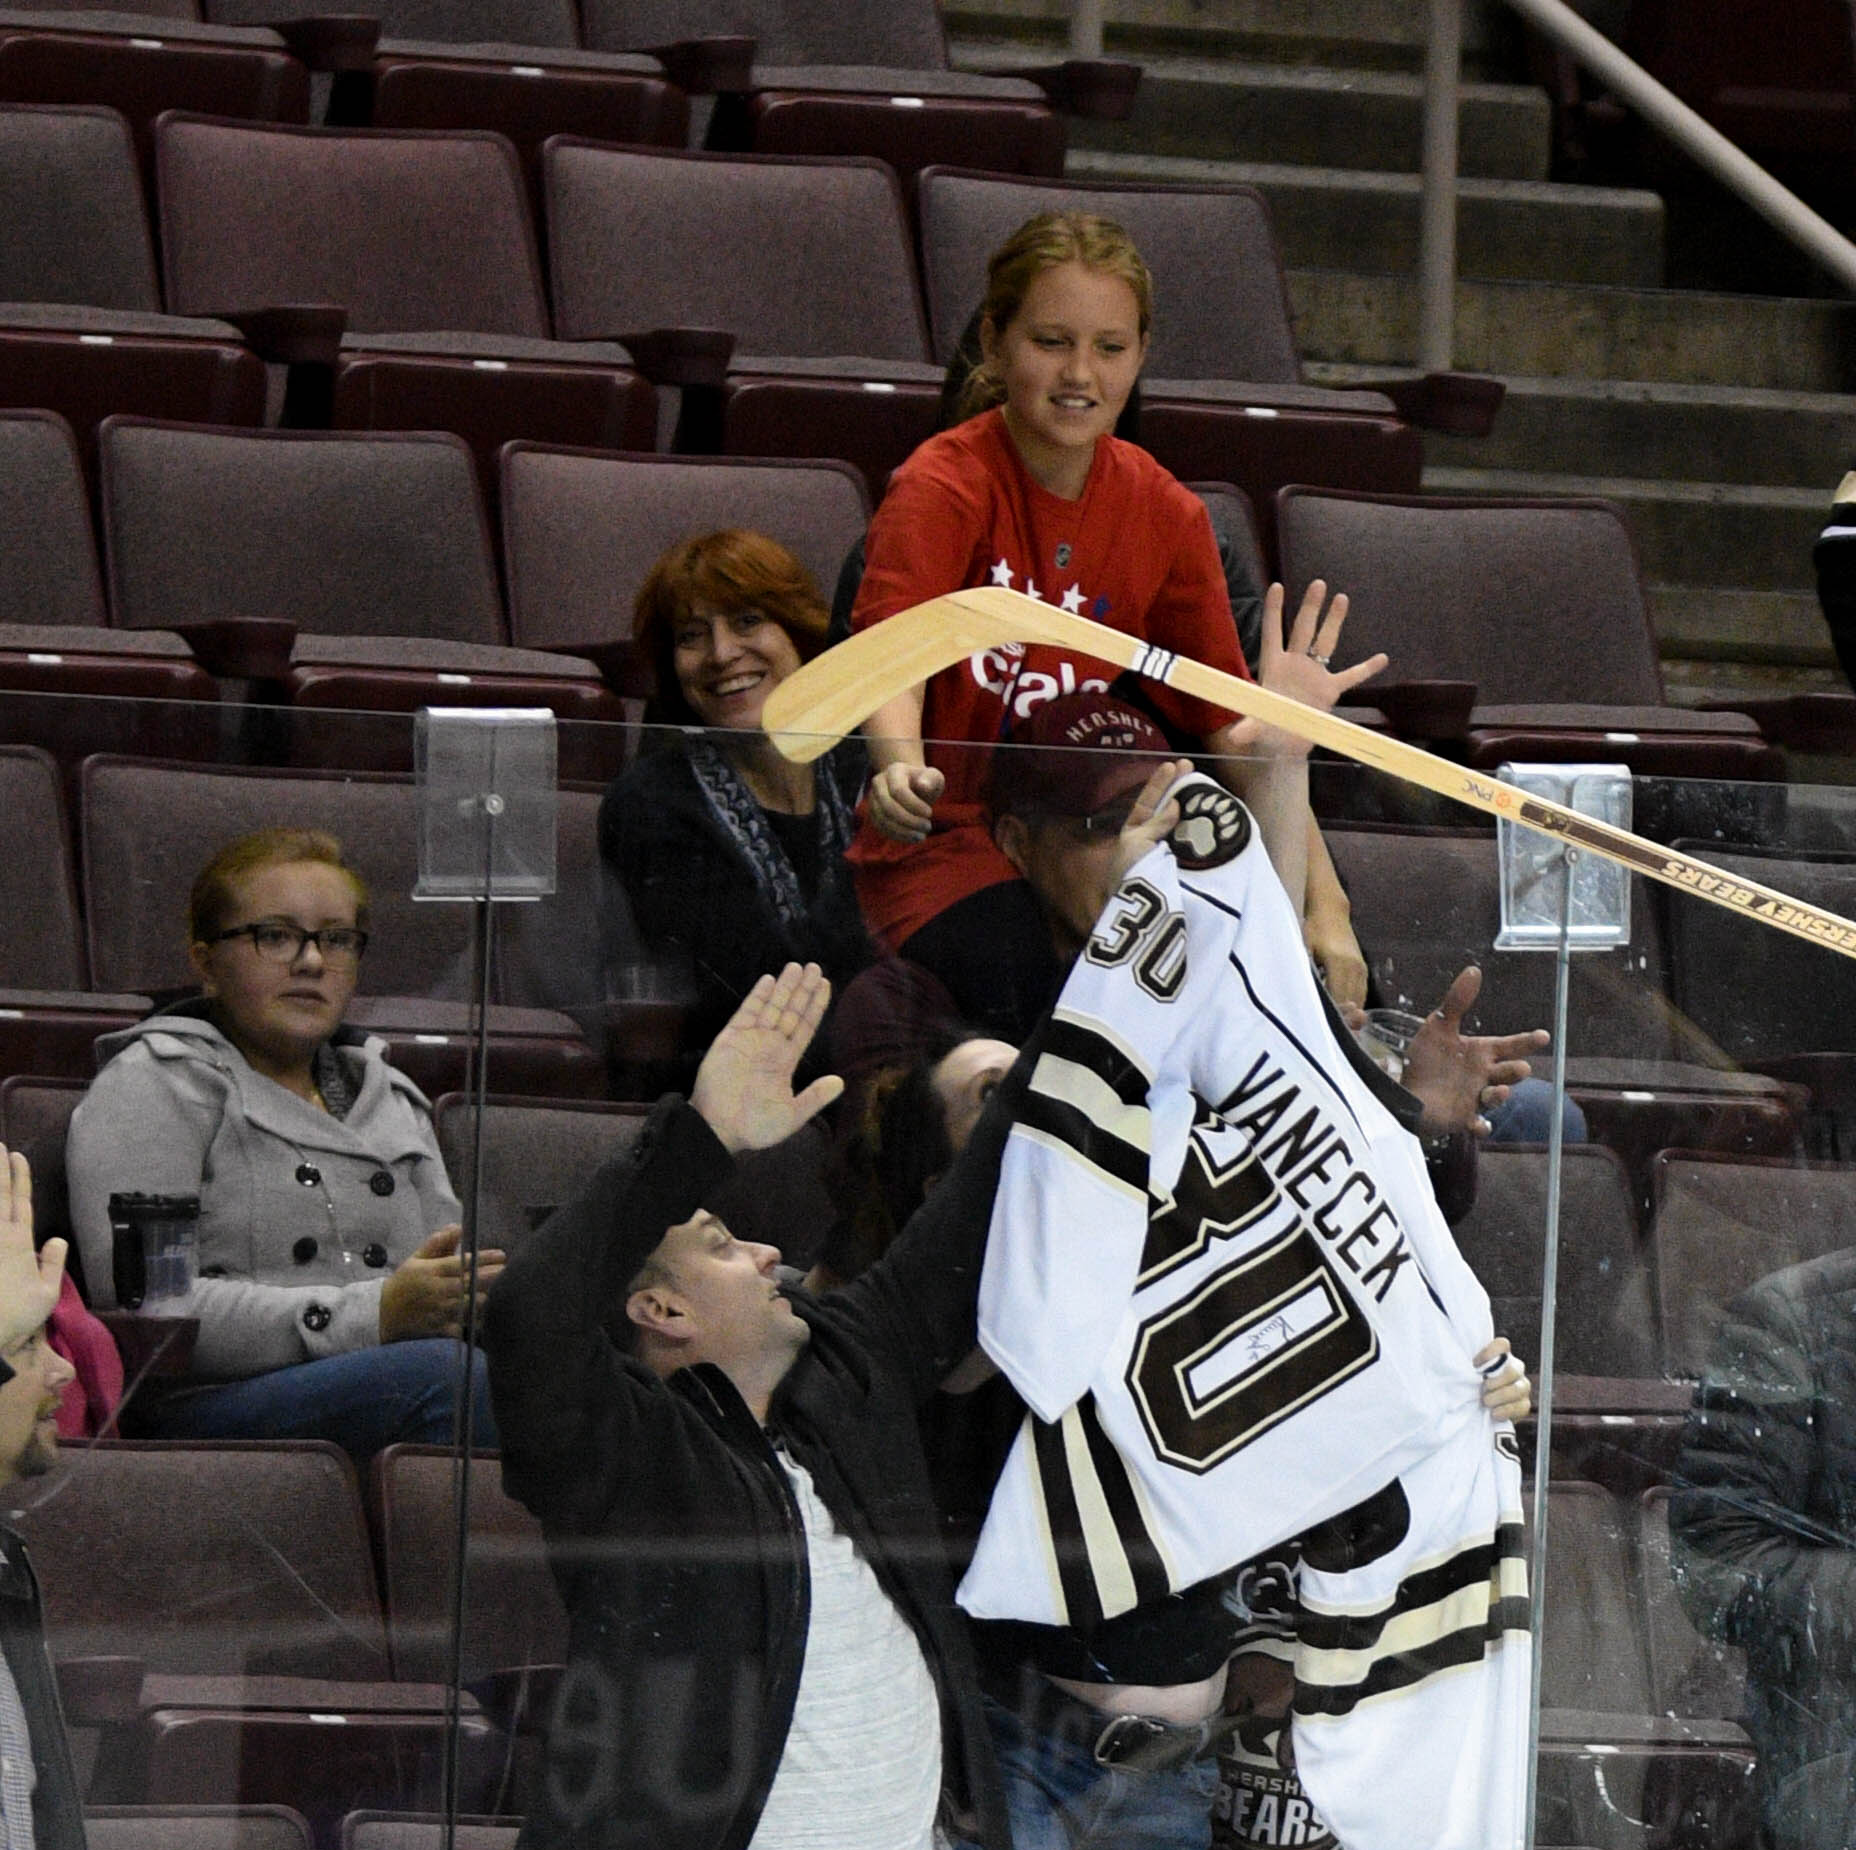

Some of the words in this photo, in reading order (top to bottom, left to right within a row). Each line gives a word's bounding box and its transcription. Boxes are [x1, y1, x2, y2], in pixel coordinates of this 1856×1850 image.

[1065, 710, 1153, 743] HERSHEY
[1660, 858, 1757, 909] BEARS
[1085, 876, 1188, 1004] 30
[1216, 1050, 1411, 1304] VANECEK
[1212, 1782, 1332, 1846] BEARS
